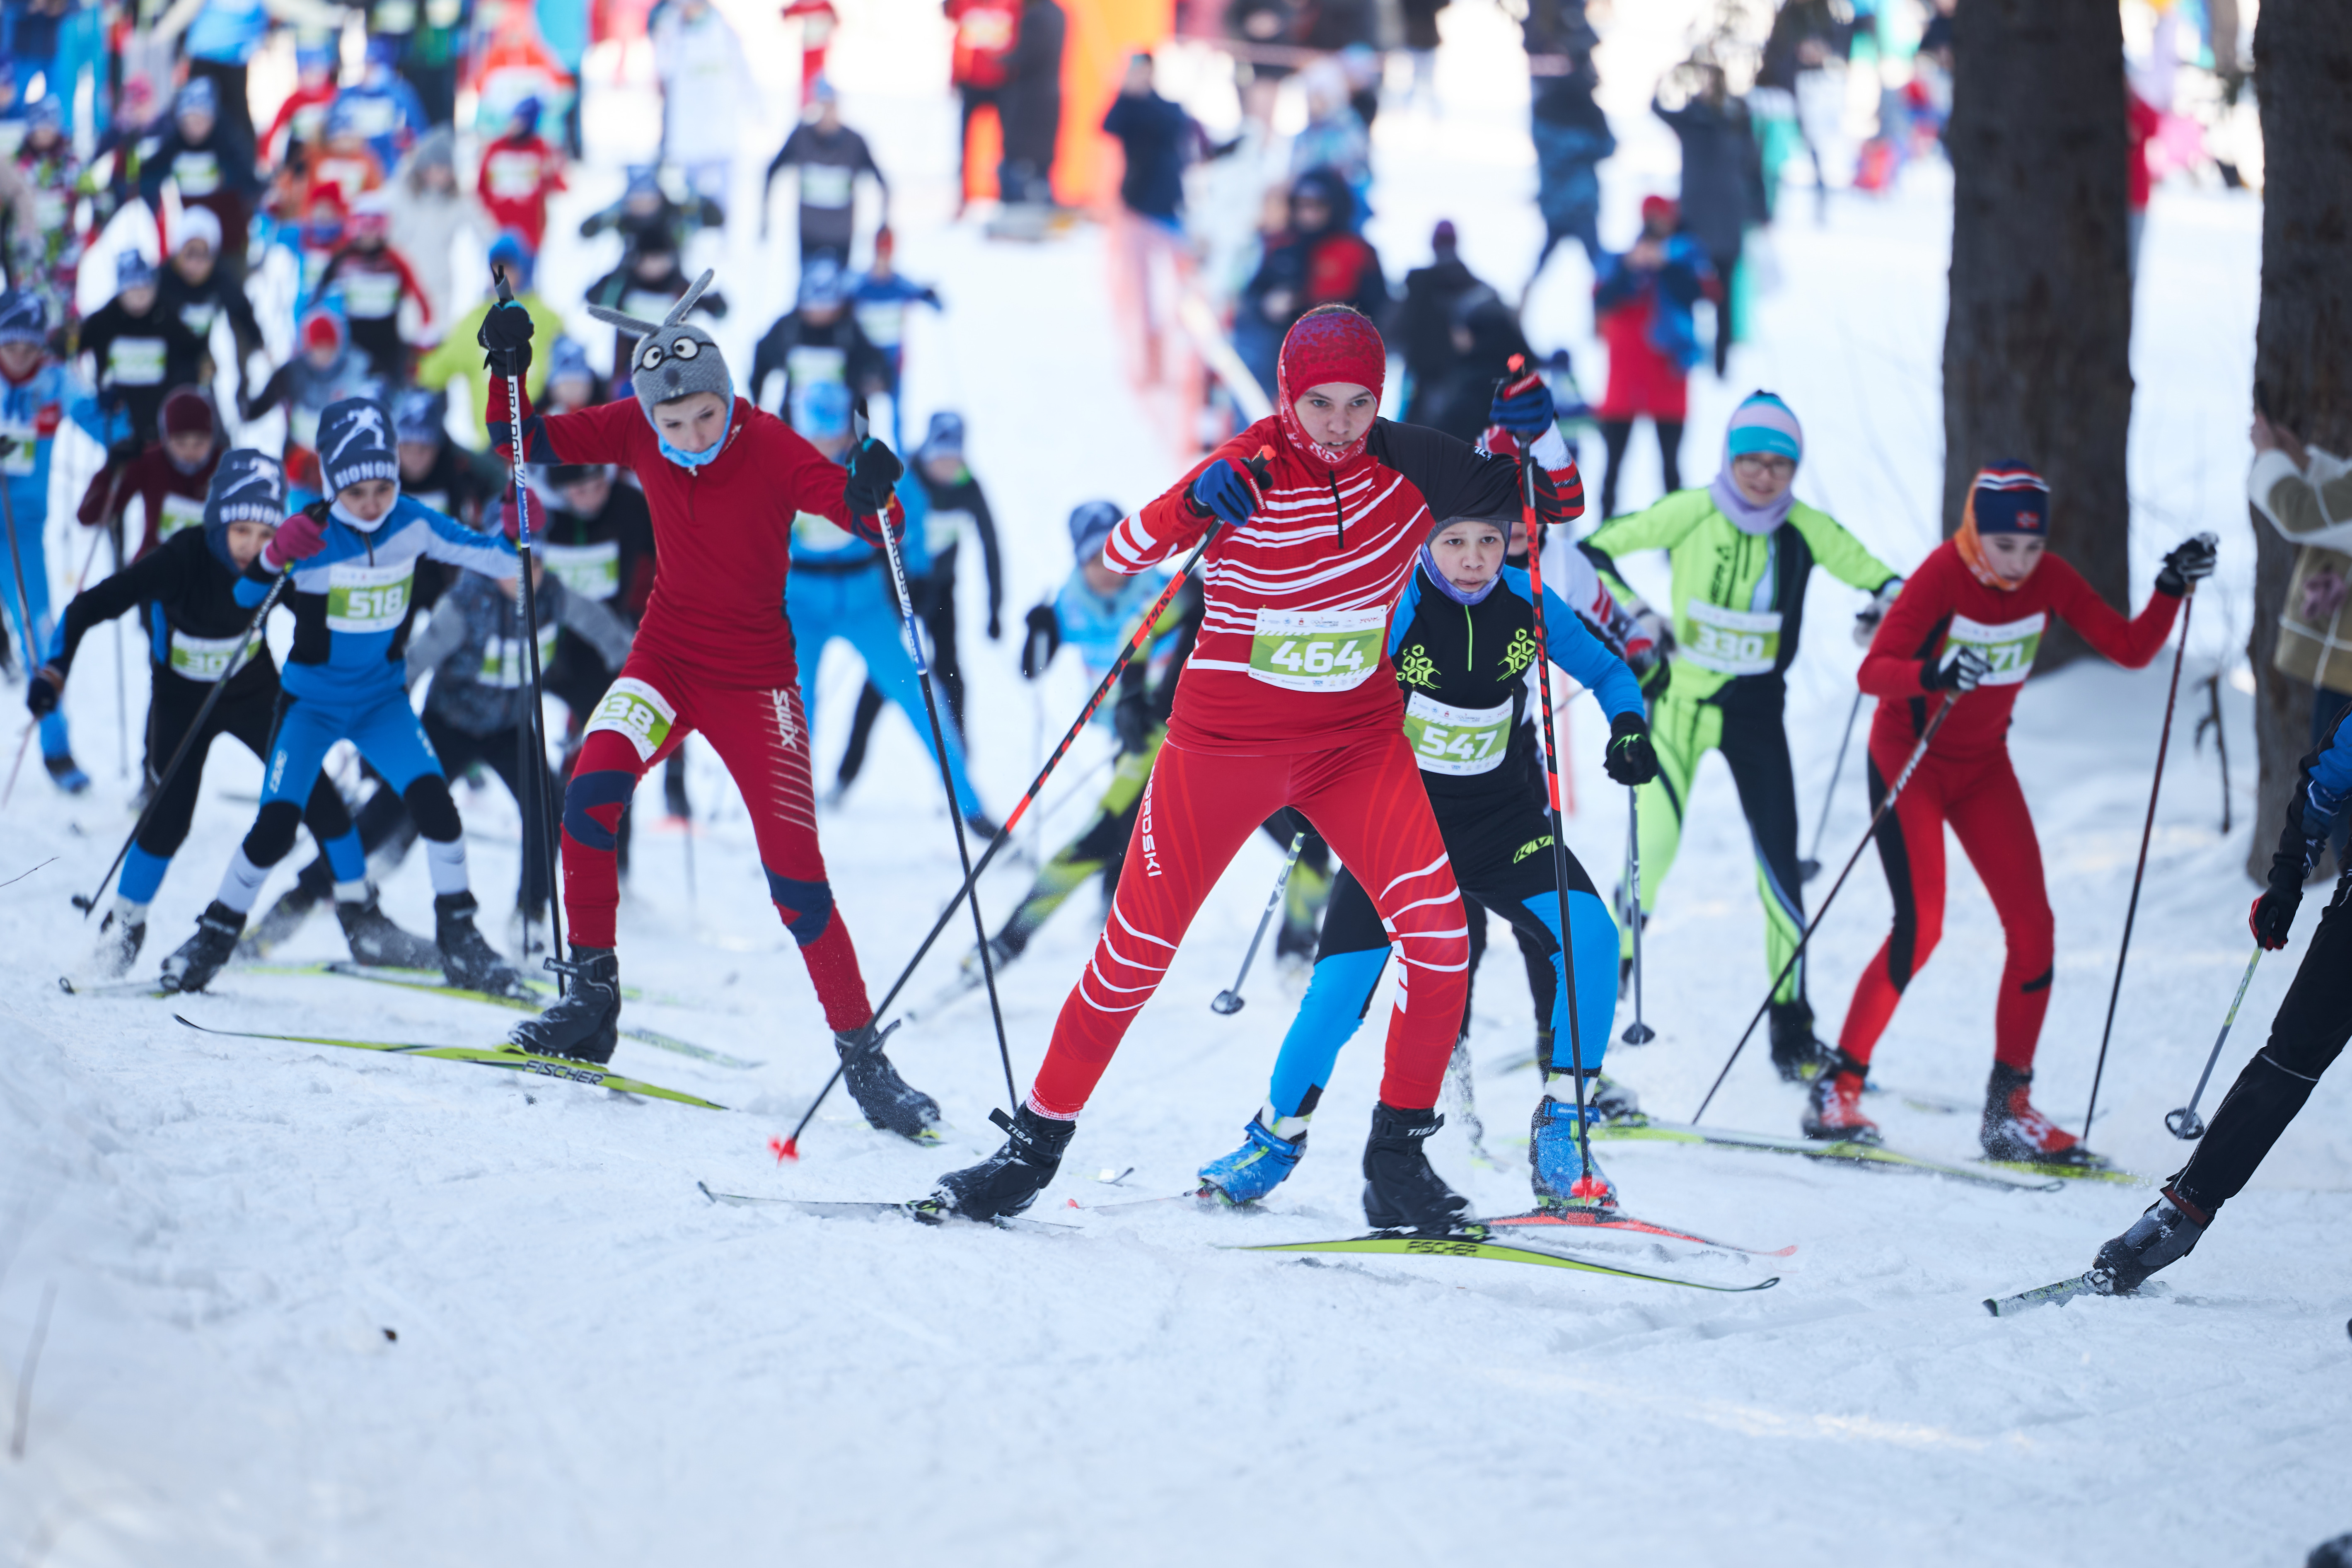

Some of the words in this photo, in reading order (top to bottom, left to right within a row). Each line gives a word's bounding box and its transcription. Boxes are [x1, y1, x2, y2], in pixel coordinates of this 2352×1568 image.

[508, 382, 521, 466] BRADOS
[883, 514, 909, 595] BRADOS
[347, 585, 404, 618] 518
[1270, 640, 1364, 673] 464
[1694, 625, 1764, 662] 330
[1533, 606, 1553, 756] TEMPESTA
[1419, 725, 1498, 760] 547
[522, 1059, 604, 1085] FISCHER
[1007, 1122, 1033, 1145] TISA
[1407, 1124, 1437, 1137] TISA
[1405, 1240, 1478, 1257] FISCHER
